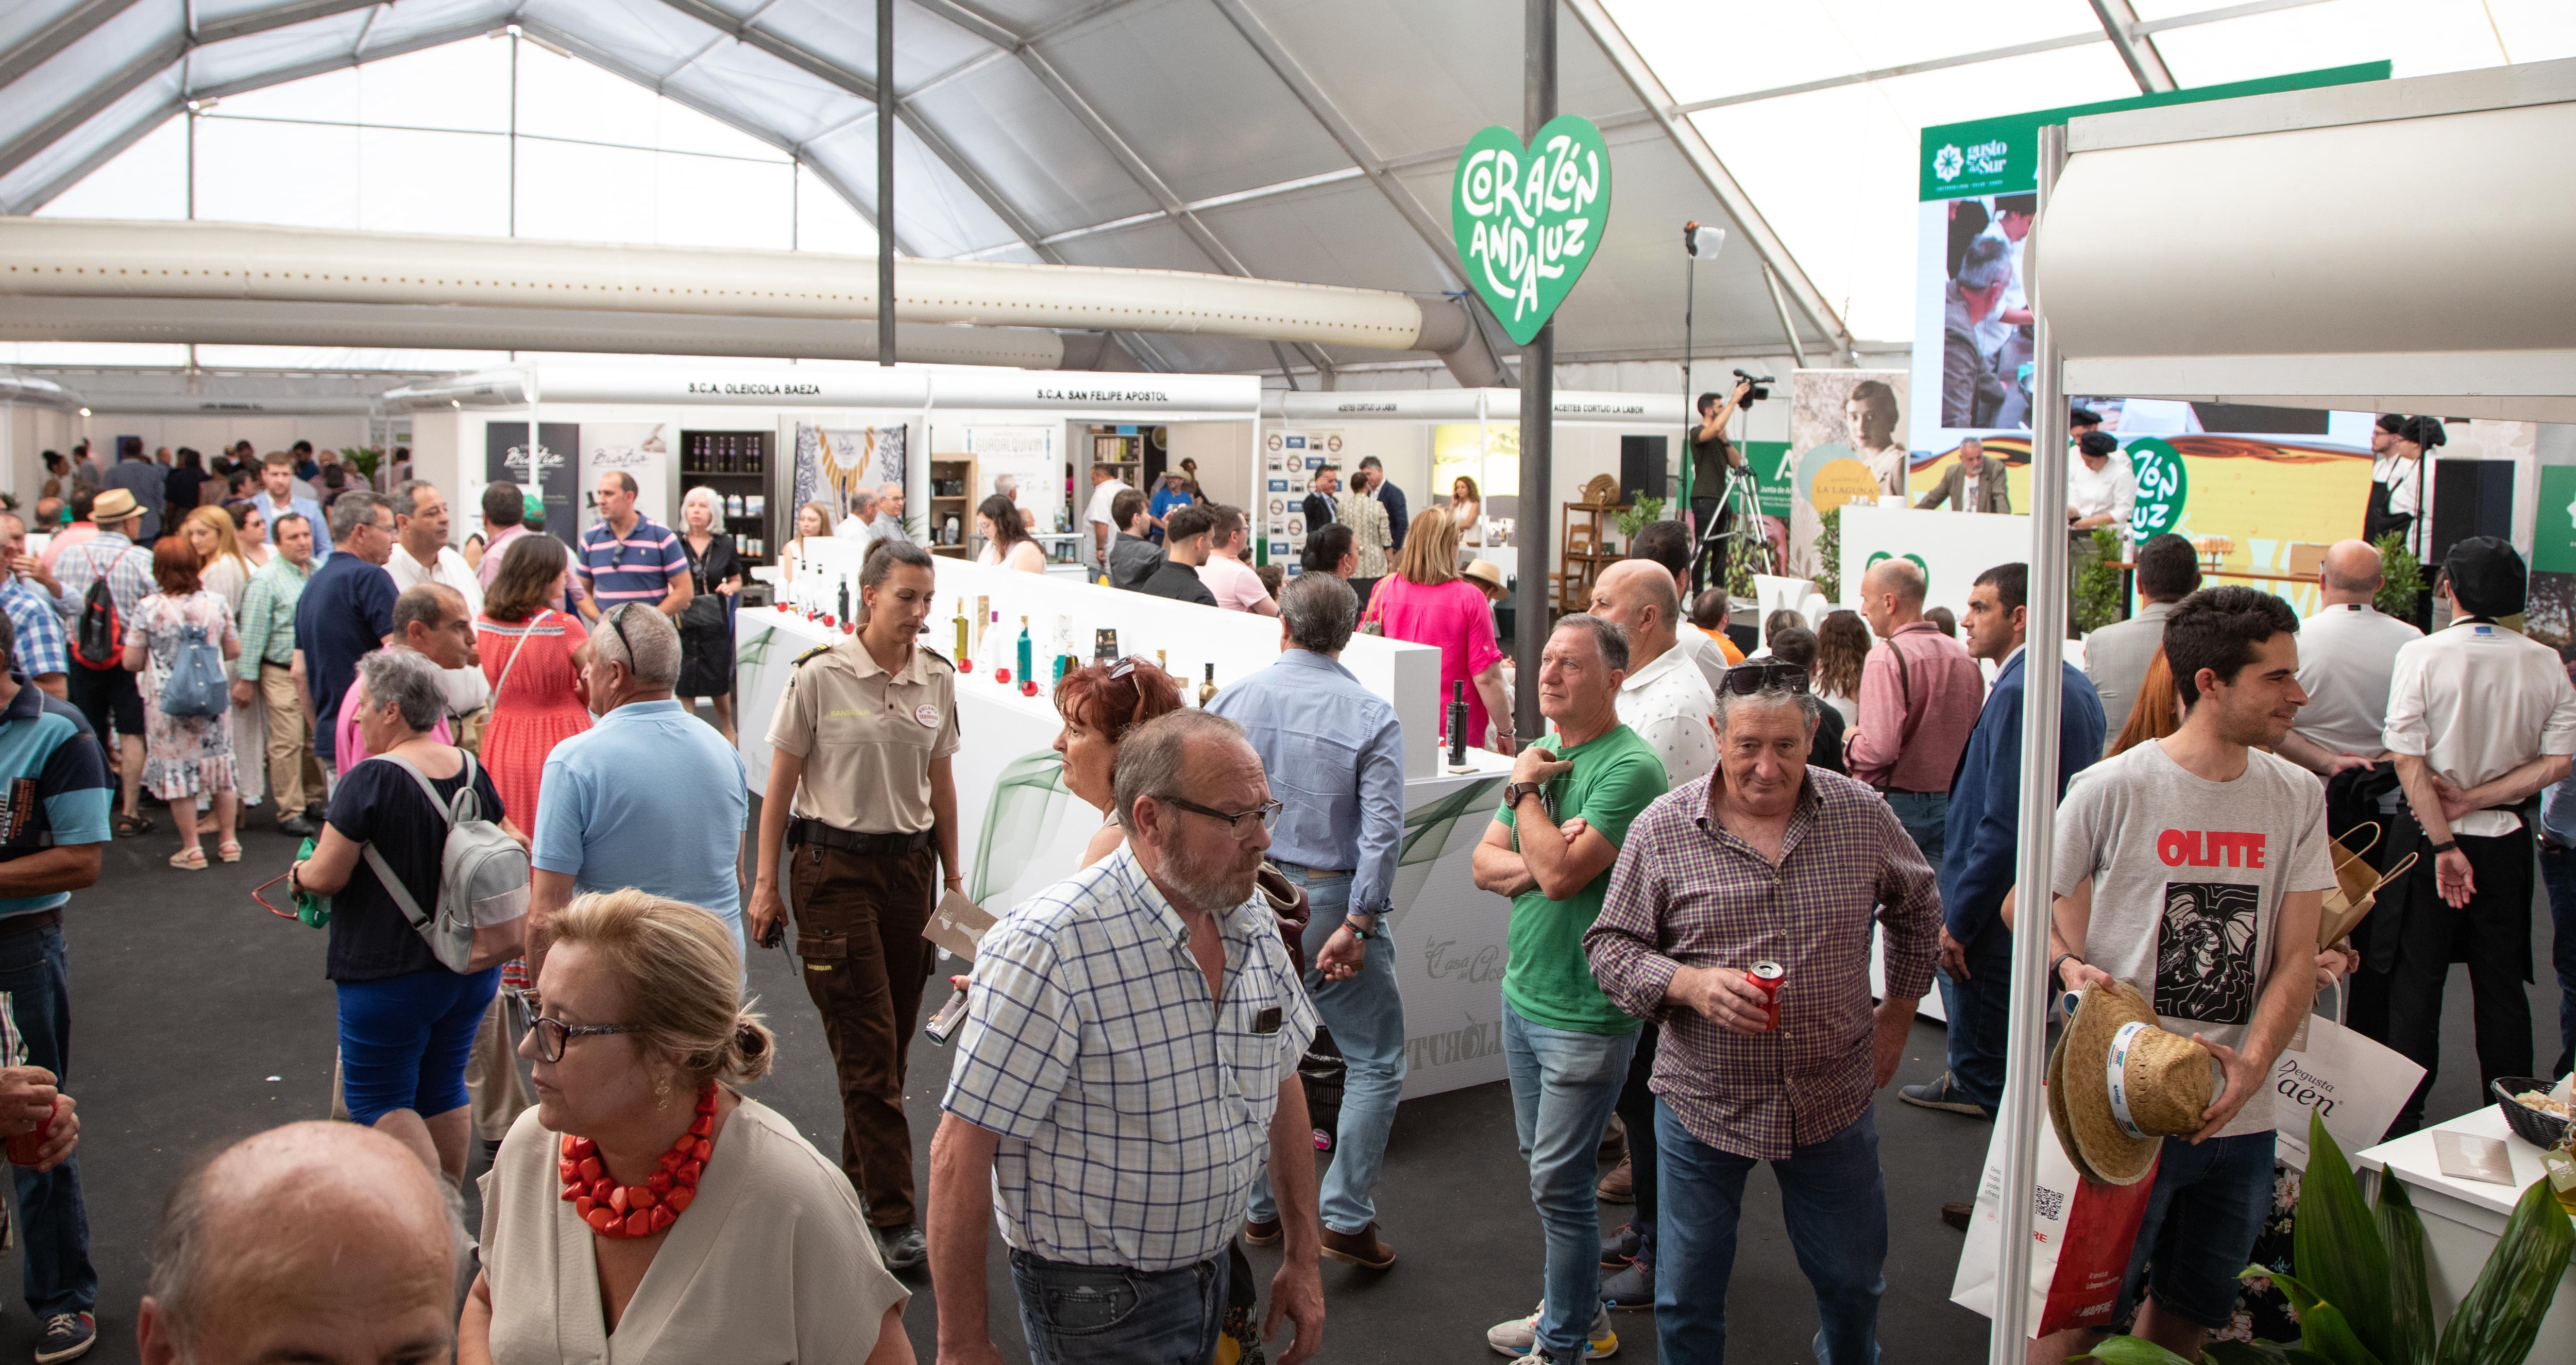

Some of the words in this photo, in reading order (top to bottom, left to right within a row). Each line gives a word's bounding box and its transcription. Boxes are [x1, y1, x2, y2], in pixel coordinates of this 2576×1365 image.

[1967, 140, 2007, 165] gusto
[1979, 156, 2007, 175] Sur
[1462, 135, 1599, 228] CORAZÓN
[1470, 216, 1589, 322] ANDALUZ
[689, 383, 720, 393] S.C.A.
[725, 384, 781, 394] OLEICOLA
[784, 384, 820, 394] BAEZA
[1037, 390, 1064, 399] S.C.A.
[1068, 390, 1087, 400] SAN
[1090, 391, 1122, 400] FELIPE
[1125, 392, 1168, 401] APOSTOL
[1583, 405, 1611, 413] CORTIJO
[1623, 406, 1644, 414] LABOR
[975, 438, 1042, 452] GUADALQUIVIR
[2157, 829, 2265, 869] OLITE
[2278, 1059, 2334, 1093] Degusta
[2079, 1300, 2113, 1317] MAPFRE
